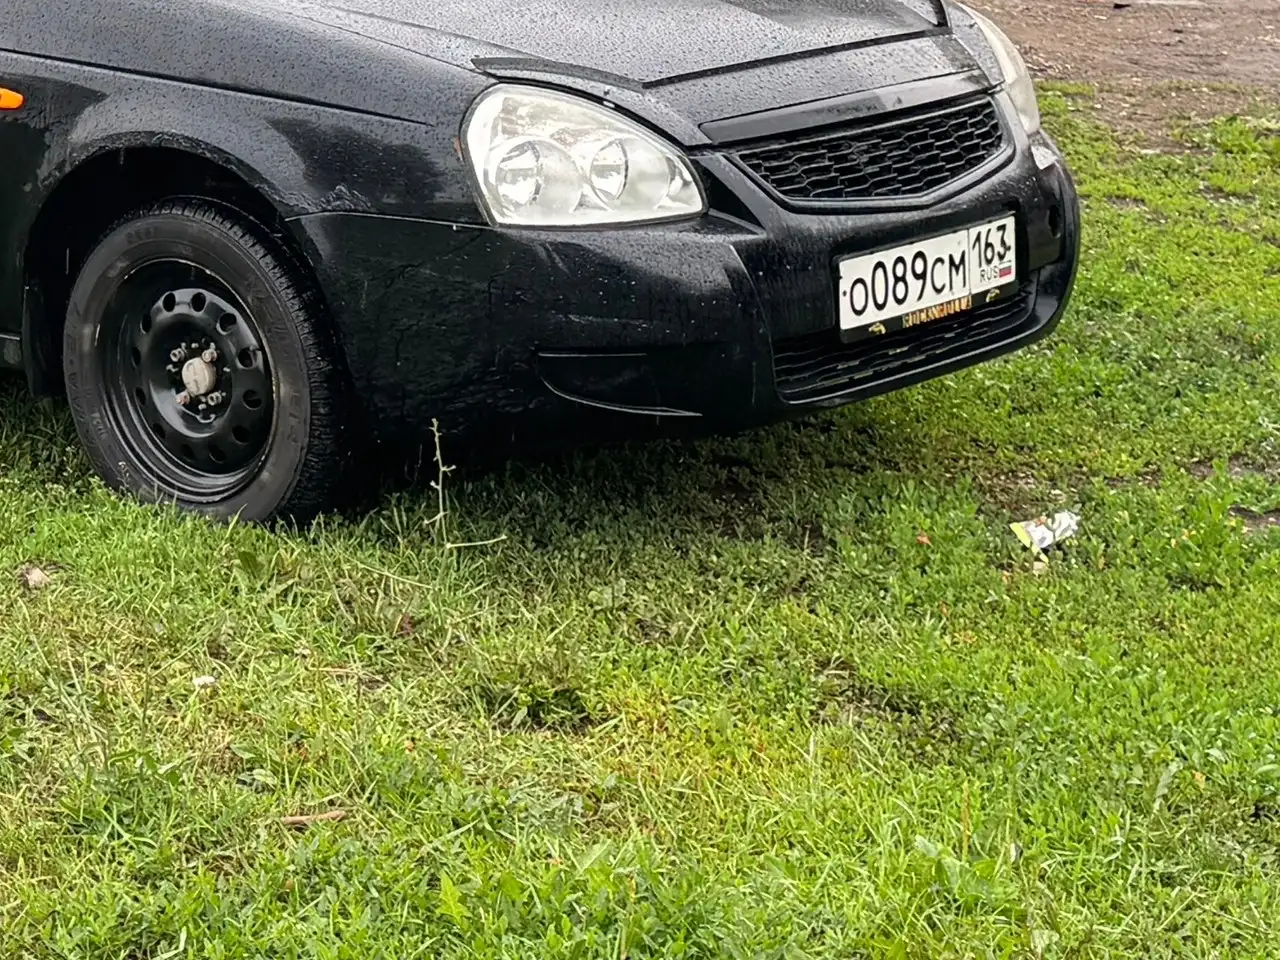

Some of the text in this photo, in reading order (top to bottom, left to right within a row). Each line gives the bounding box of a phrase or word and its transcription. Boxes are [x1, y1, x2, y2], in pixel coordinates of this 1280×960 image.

[849, 224, 1011, 317] О089СМ 163
[979, 267, 1000, 283] RUS
